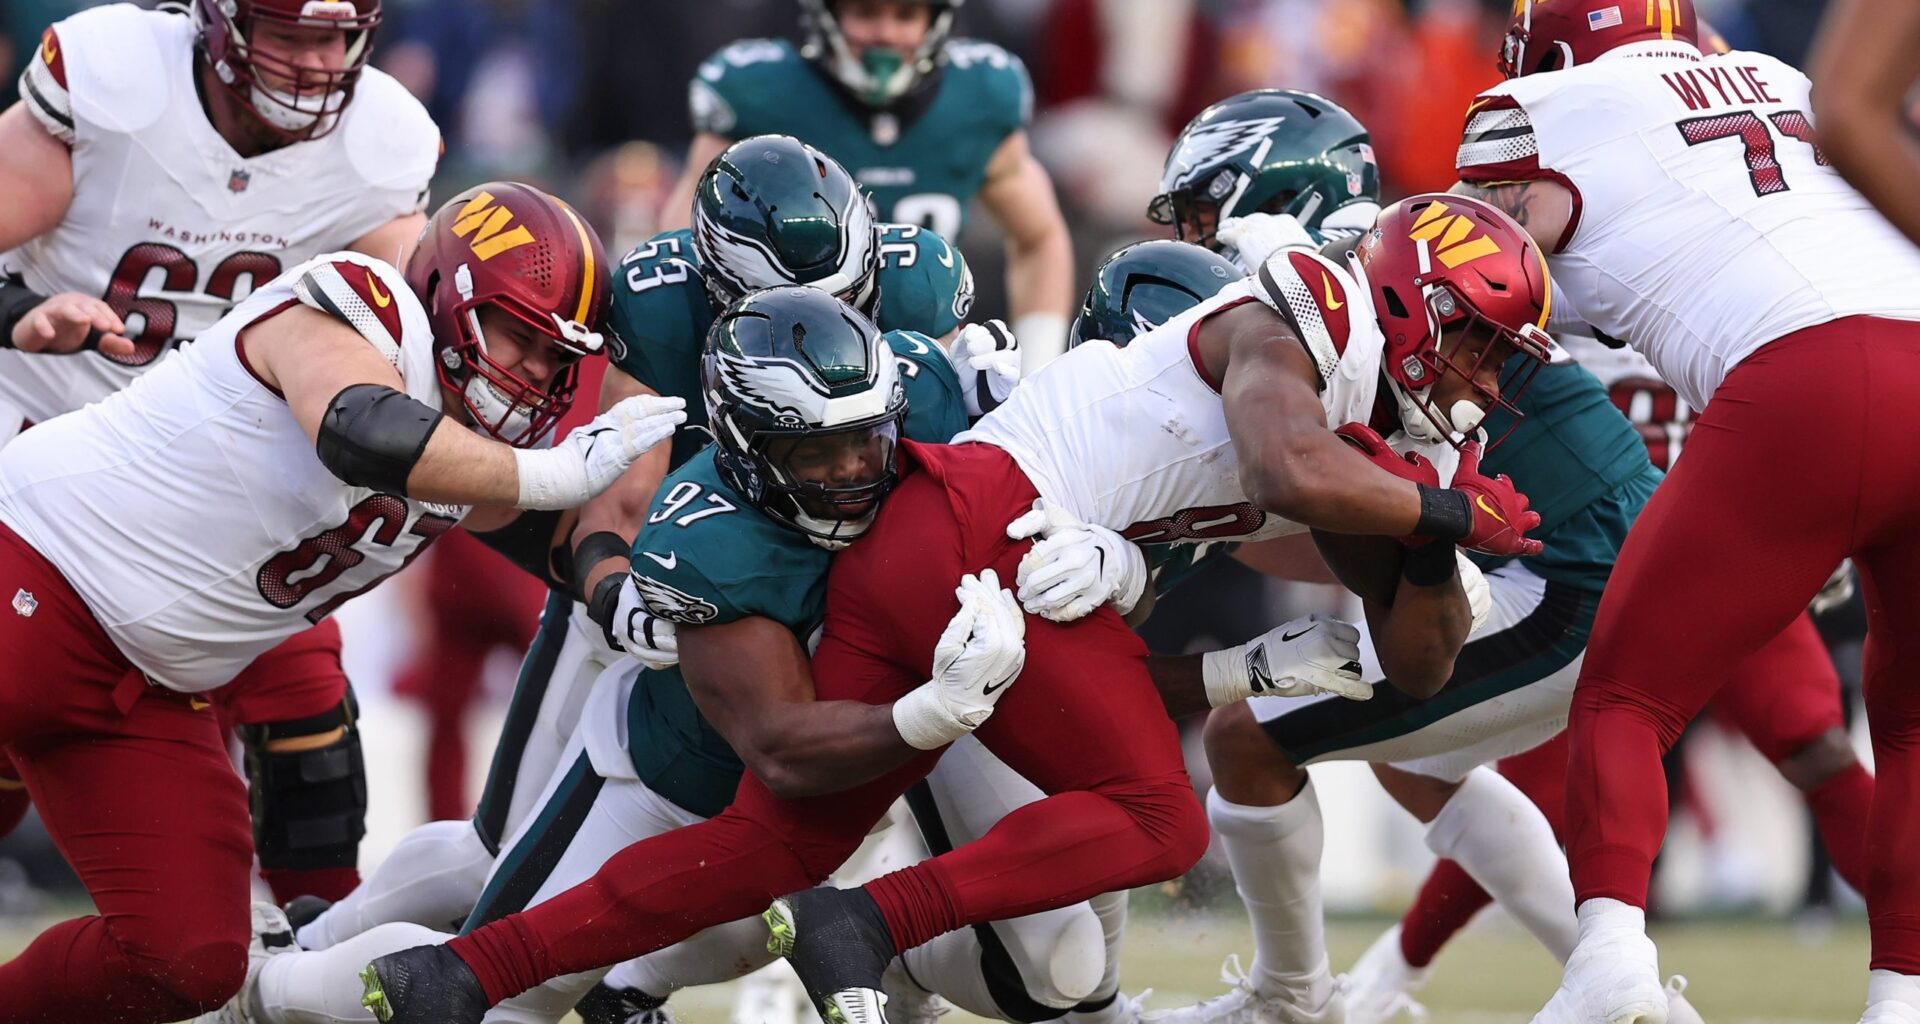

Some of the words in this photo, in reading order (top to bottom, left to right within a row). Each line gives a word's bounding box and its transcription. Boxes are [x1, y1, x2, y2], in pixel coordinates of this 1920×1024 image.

[1660, 66, 1782, 111] WYLIE
[149, 217, 289, 249] WASHINGTON
[774, 421, 805, 430] OAKLEY
[647, 480, 738, 528] 97
